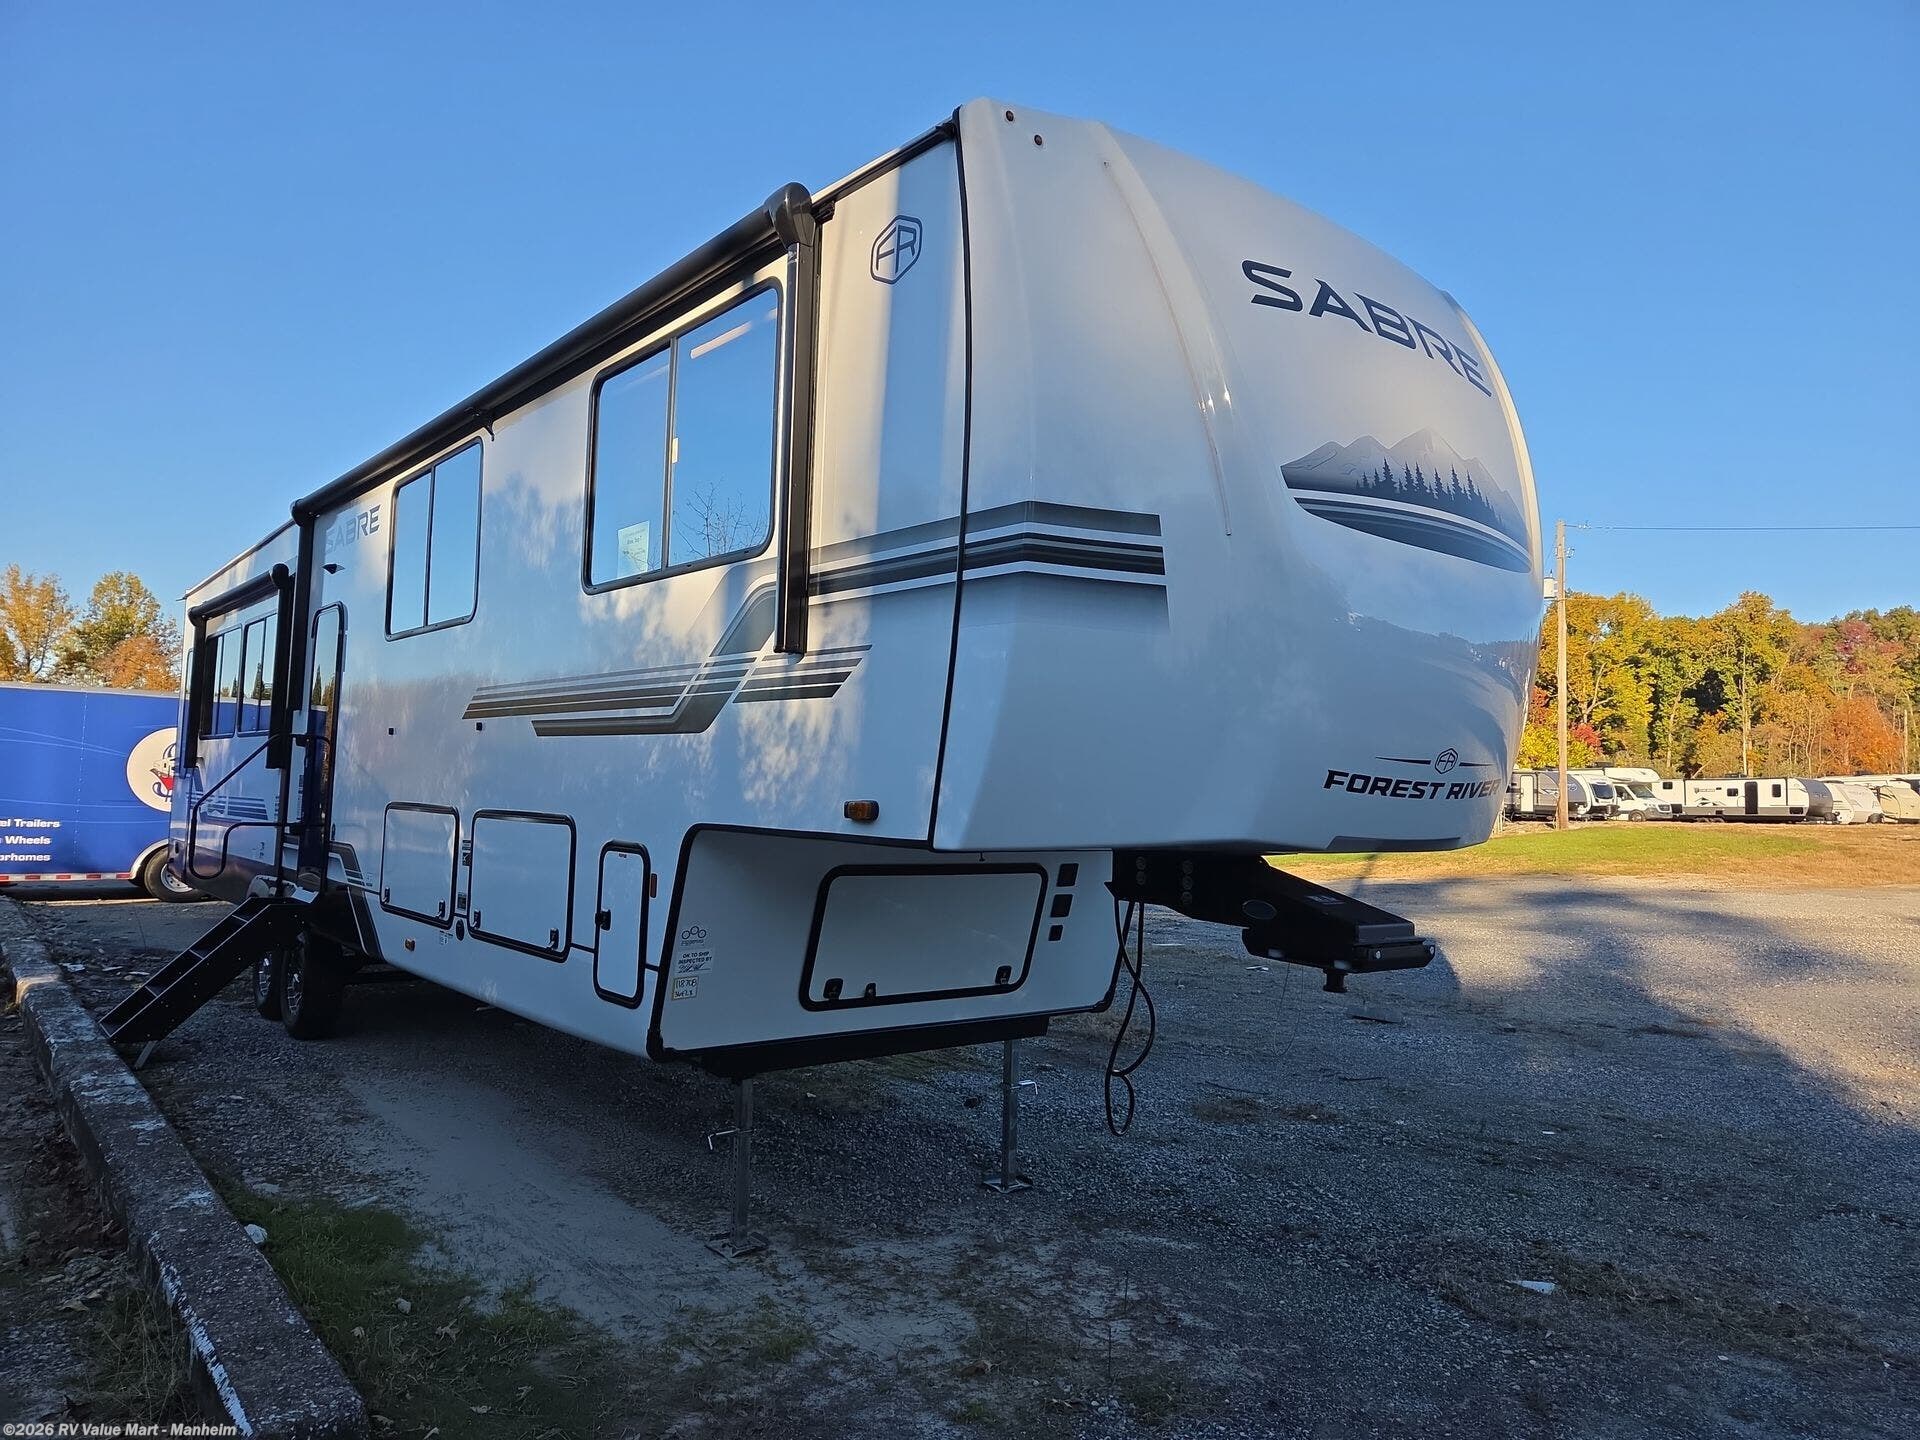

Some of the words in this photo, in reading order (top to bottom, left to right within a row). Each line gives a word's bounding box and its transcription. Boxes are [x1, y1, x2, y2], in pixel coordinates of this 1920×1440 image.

[1241, 258, 1492, 398] SABRE
[325, 504, 381, 554] SABRE
[1323, 769, 1446, 800] FOREST
[1446, 778, 1502, 800] RIVER
[14, 818, 61, 828] Trailers
[4, 835, 51, 845] Wheels
